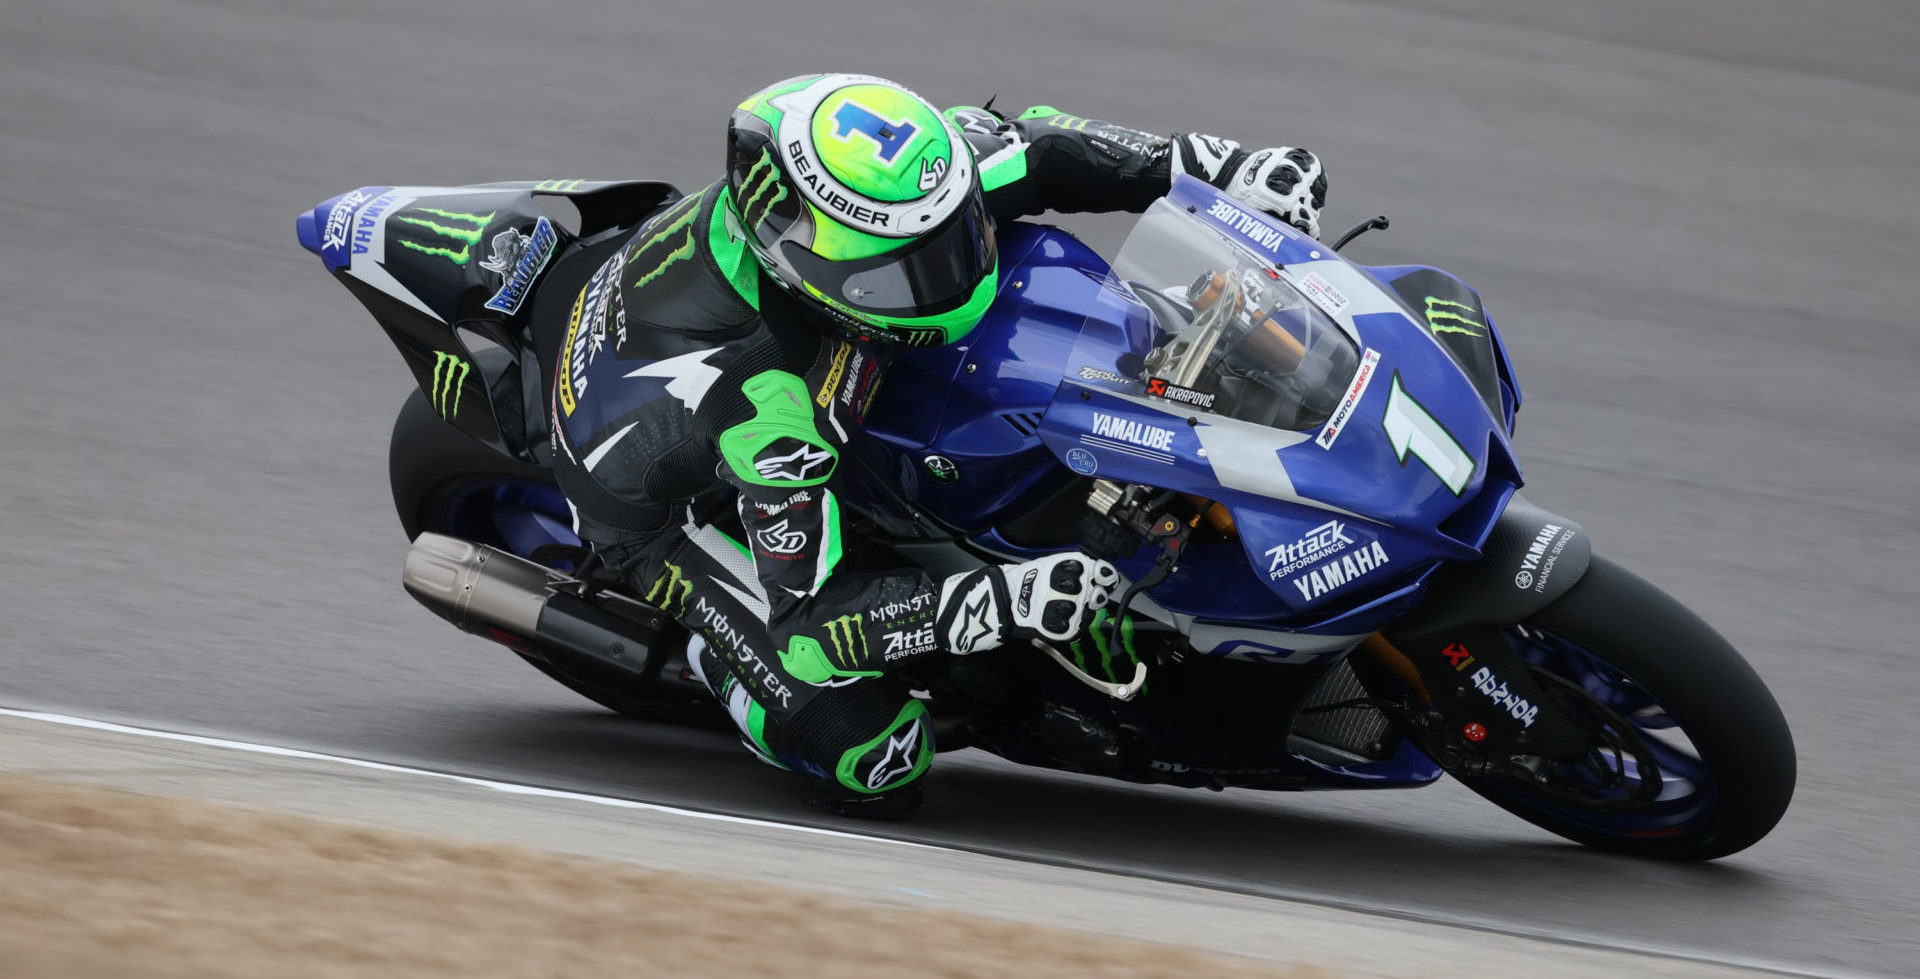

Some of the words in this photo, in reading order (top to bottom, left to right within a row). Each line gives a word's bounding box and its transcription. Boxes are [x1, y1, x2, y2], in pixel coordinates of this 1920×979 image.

[829, 97, 922, 167] 1
[788, 139, 890, 228] BEAUBIER
[1206, 198, 1285, 254] YAMALUBE
[488, 217, 557, 315] BEAUBIER
[1333, 364, 1372, 429] MOTOAMERICA
[1092, 411, 1176, 452] YAMALUBE
[1381, 367, 1477, 498] 1
[1264, 519, 1355, 573] Attack
[1269, 540, 1346, 582] PERFORMANCE
[1292, 540, 1390, 602] YAMAHA
[1520, 523, 1562, 570] YAMAHA
[1535, 555, 1558, 593] FINANCIAL
[1551, 529, 1576, 555] SERVICES
[869, 593, 934, 623] MONST
[882, 622, 936, 655] Atta
[884, 643, 938, 662] PERFORMA
[1470, 666, 1539, 729] DUNLOP
